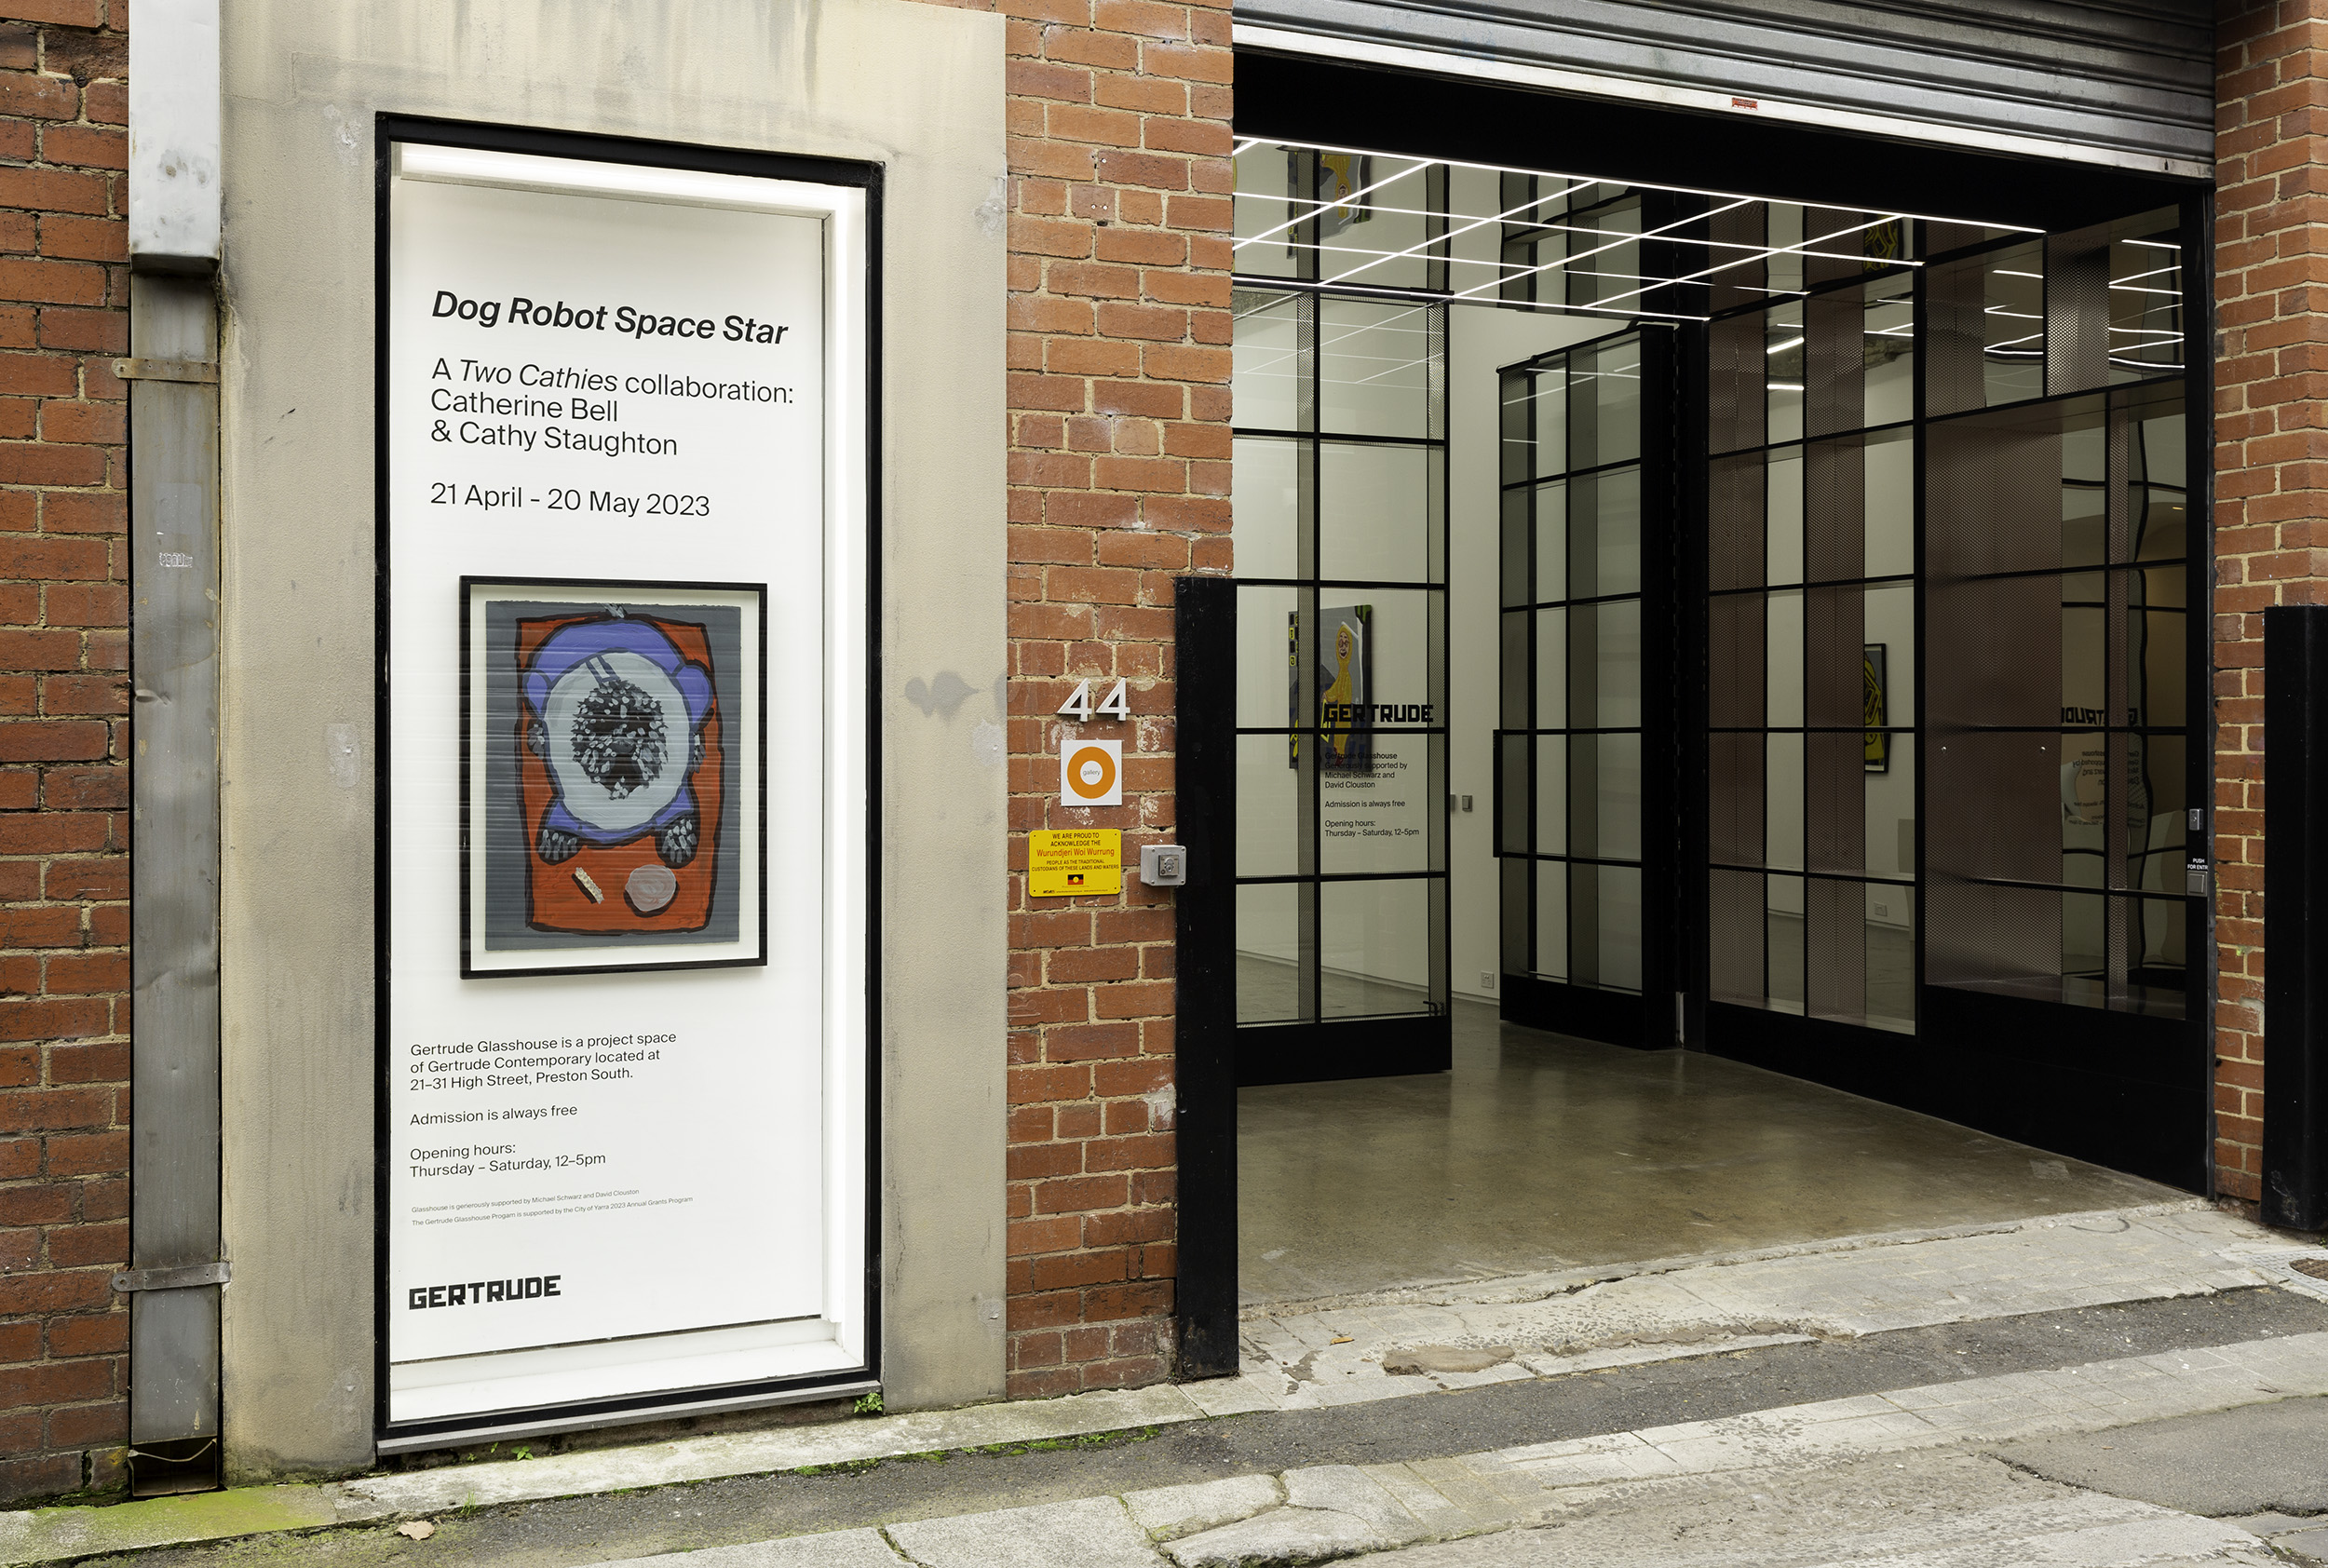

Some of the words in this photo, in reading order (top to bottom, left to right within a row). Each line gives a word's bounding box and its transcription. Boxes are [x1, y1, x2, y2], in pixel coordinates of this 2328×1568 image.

[432, 290, 502, 329] Dog
[508, 297, 608, 331] Robot
[614, 305, 716, 339] Space
[722, 314, 789, 345] Star
[431, 357, 452, 381] A
[458, 358, 513, 385] Two
[519, 363, 618, 392] Cathies
[624, 372, 793, 404] collaboration:
[430, 388, 563, 419] Catherine
[571, 398, 618, 422] Bell
[430, 419, 453, 443] &
[459, 421, 537, 452] Cathy
[544, 426, 677, 457] Staughton
[430, 482, 457, 505] 21
[464, 483, 522, 510] April
[548, 489, 581, 510] 20
[589, 490, 641, 518] May
[646, 493, 711, 517] 2023
[1057, 678, 1130, 723] 44
[1323, 704, 1433, 723] GERTRUDE
[1369, 800, 1390, 808] always
[1036, 849, 1073, 858] Wurundjeri
[1088, 848, 1115, 857] Wurrung
[411, 1042, 474, 1056] Gertrude
[477, 1038, 558, 1052] Glasshouse
[561, 1036, 573, 1048] is
[575, 1037, 584, 1048] a
[587, 1034, 633, 1049] project
[636, 1033, 677, 1047] space
[411, 1061, 424, 1074] of
[427, 1059, 491, 1073] Gertrude
[494, 1053, 592, 1070] Contemporary
[595, 1050, 644, 1063] located
[647, 1049, 660, 1060] at
[451, 1075, 483, 1090] High
[486, 1073, 533, 1088] Street,
[535, 1069, 588, 1084] Preston
[590, 1066, 633, 1080] South.
[410, 1110, 484, 1126] Admission
[487, 1109, 498, 1121] is
[502, 1107, 548, 1122] always
[550, 1104, 578, 1116] free
[411, 1145, 469, 1161] Opening
[473, 1143, 516, 1156] hours:
[410, 1163, 475, 1178] Thursday
[489, 1156, 551, 1173] Saturday,
[454, 1214, 490, 1223] Glasshouse
[523, 1209, 554, 1218] supported
[669, 1196, 693, 1205] Program
[455, 1202, 490, 1210] generously
[491, 1199, 522, 1208] supported
[409, 1275, 561, 1310] GERTRUDE
